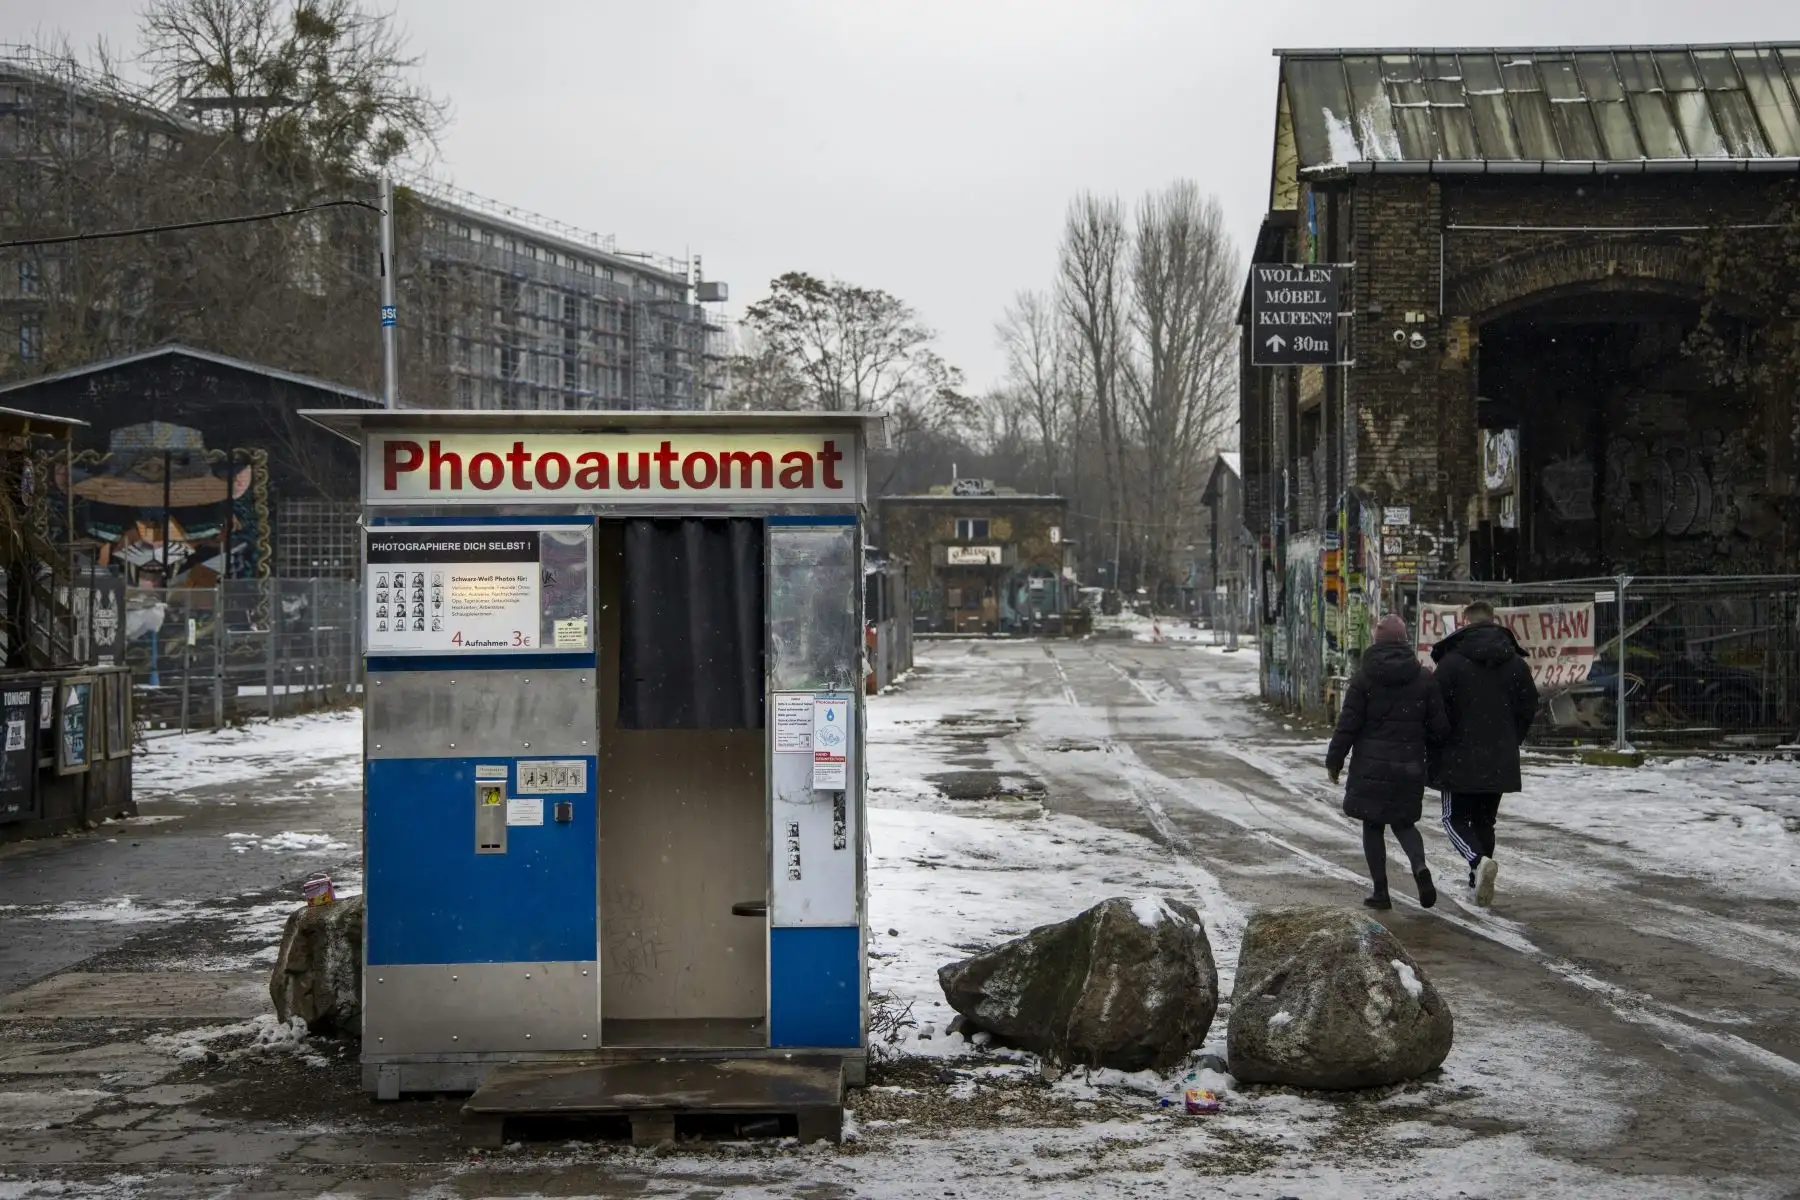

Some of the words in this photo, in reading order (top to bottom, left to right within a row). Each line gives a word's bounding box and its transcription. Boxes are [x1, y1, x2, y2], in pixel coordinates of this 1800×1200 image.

[1259, 269, 1332, 283] WOLLEN
[1265, 288, 1327, 304] MÖBEL
[1259, 311, 1332, 325] KAUFEN?!
[1293, 336, 1329, 352] 30m
[383, 440, 843, 491] Photoautomat
[372, 542, 461, 551] PHOTOGRAPHIERE
[463, 542, 486, 550] DICH
[488, 542, 525, 550] SELBST
[1539, 609, 1590, 640] RAW
[451, 630, 464, 647] 4
[512, 630, 531, 647] 3€
[1565, 663, 1587, 685] 52
[3, 691, 31, 705] TONIGHT
